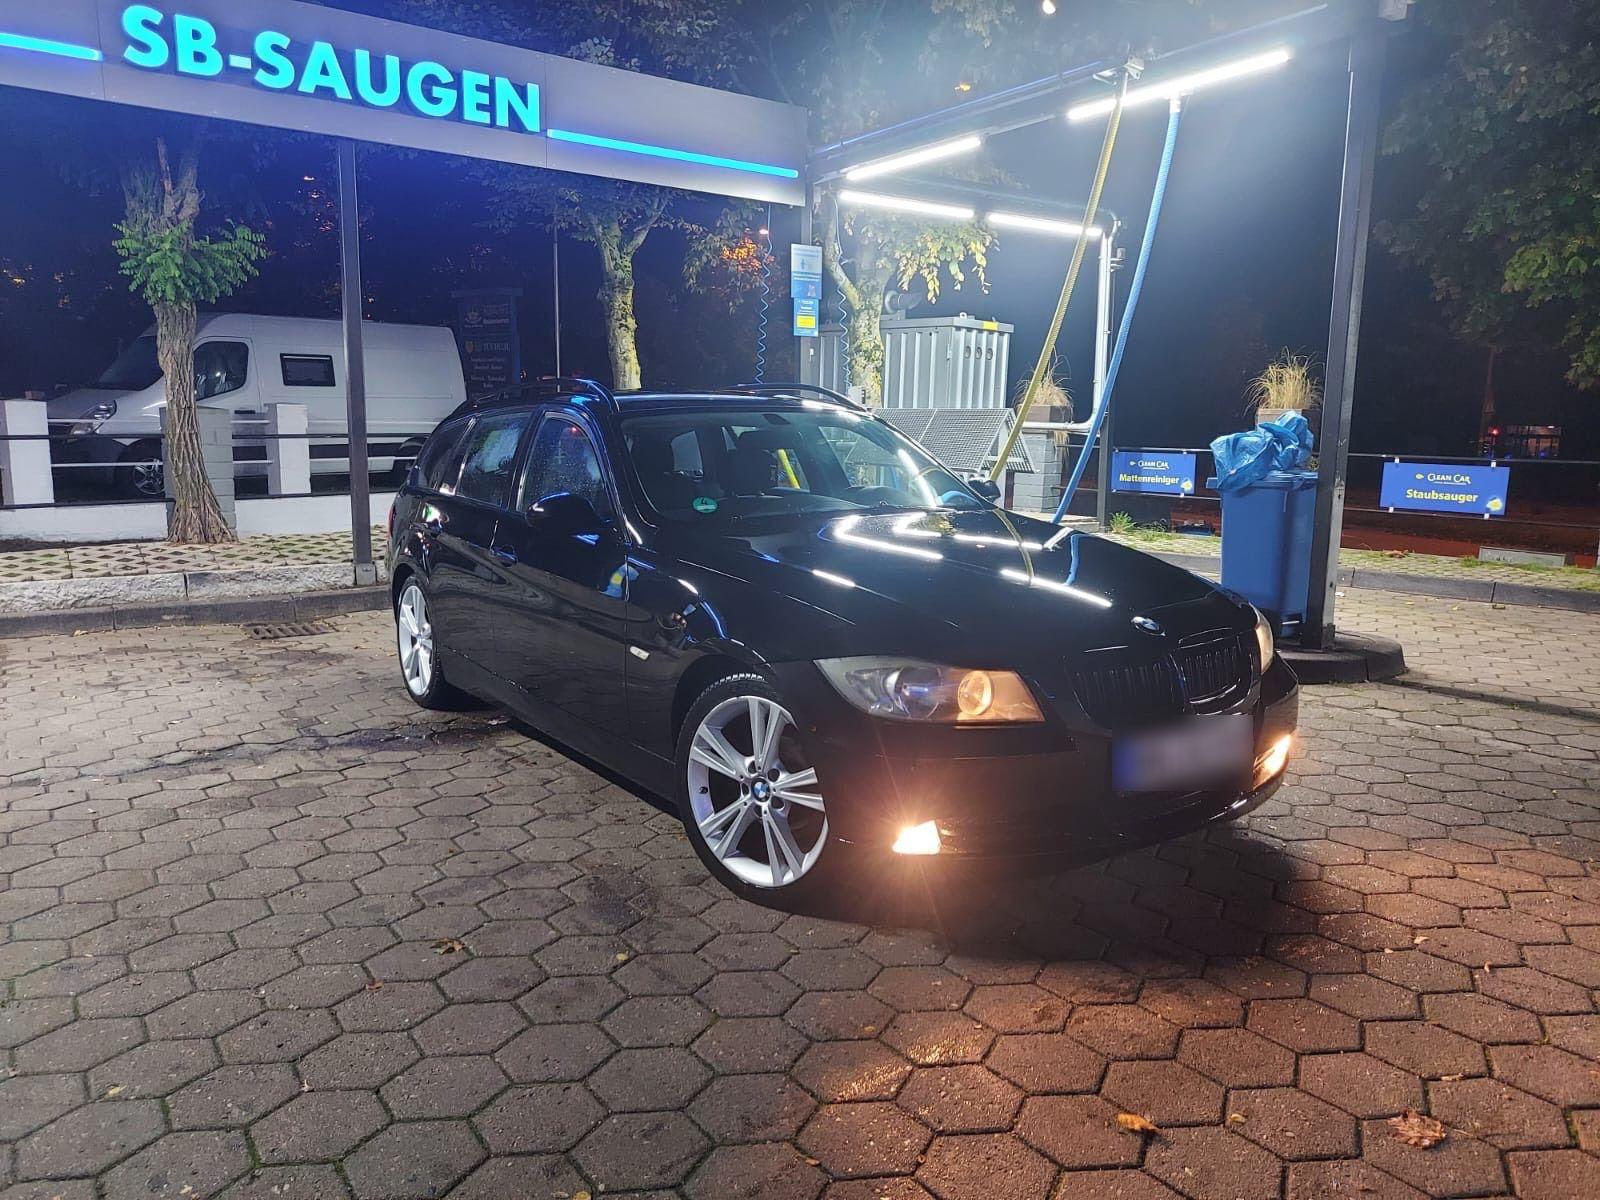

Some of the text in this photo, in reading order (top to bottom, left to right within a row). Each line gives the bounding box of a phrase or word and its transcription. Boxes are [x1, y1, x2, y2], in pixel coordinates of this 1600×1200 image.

[121, 4, 541, 133] SB-SAUGEN
[1119, 473, 1179, 486] Mattenreiniger
[1427, 472, 1452, 482] CLEAN
[1453, 474, 1471, 485] CAR
[1406, 488, 1479, 504] Staubsauger
